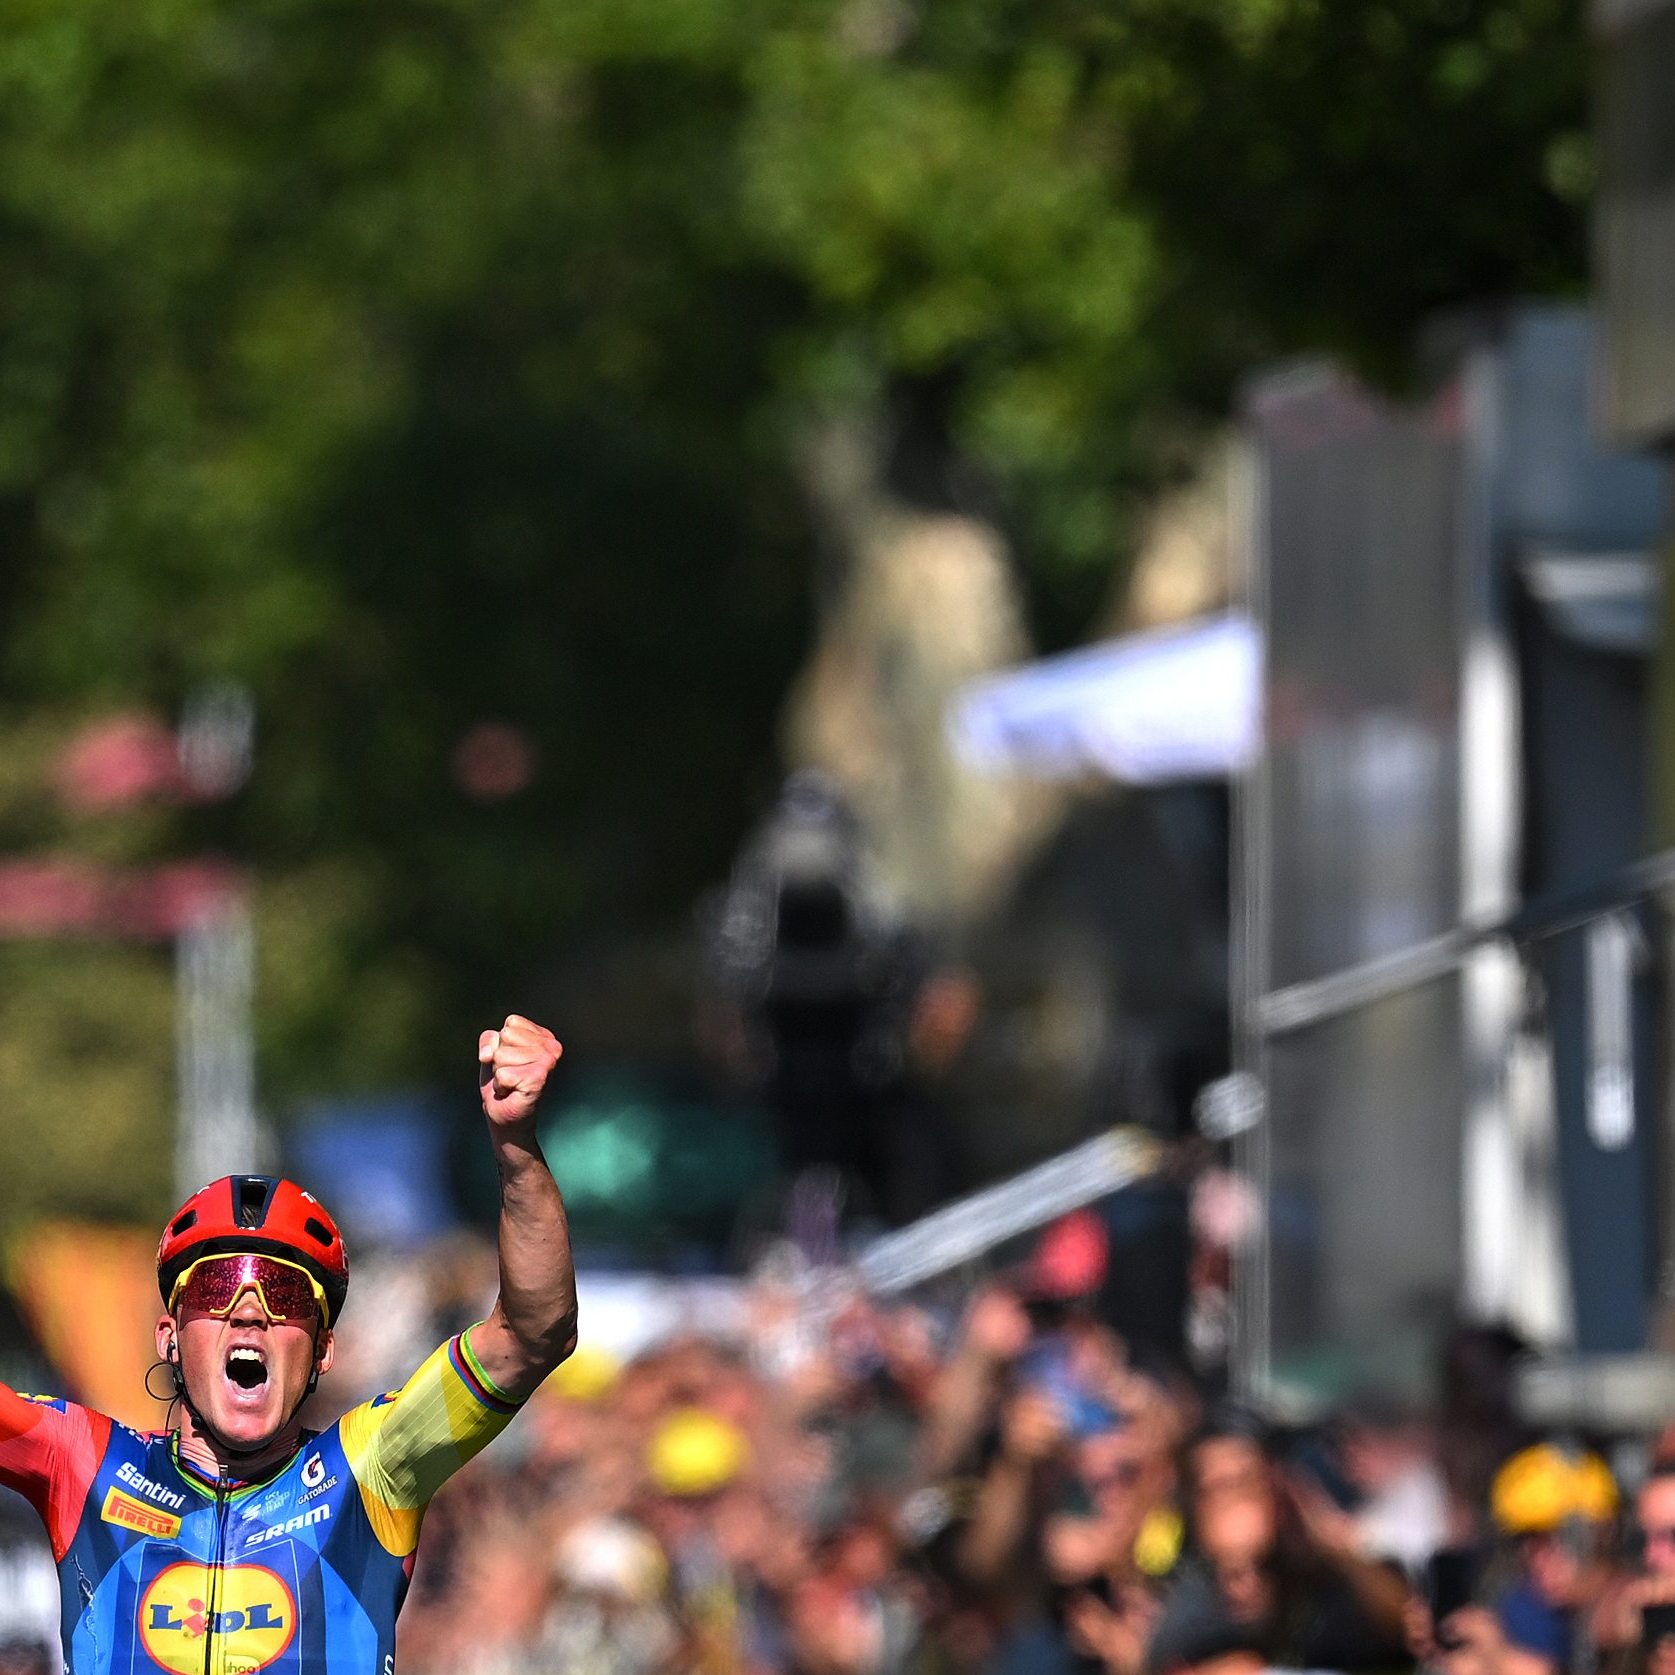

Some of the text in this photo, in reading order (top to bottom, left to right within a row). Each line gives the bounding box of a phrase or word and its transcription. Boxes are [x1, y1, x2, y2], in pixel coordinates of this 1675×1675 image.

[115, 1461, 187, 1509] Santini
[297, 1475, 338, 1505] GATORADE
[108, 1495, 174, 1534] PIRELLI
[244, 1503, 330, 1548] SRAM
